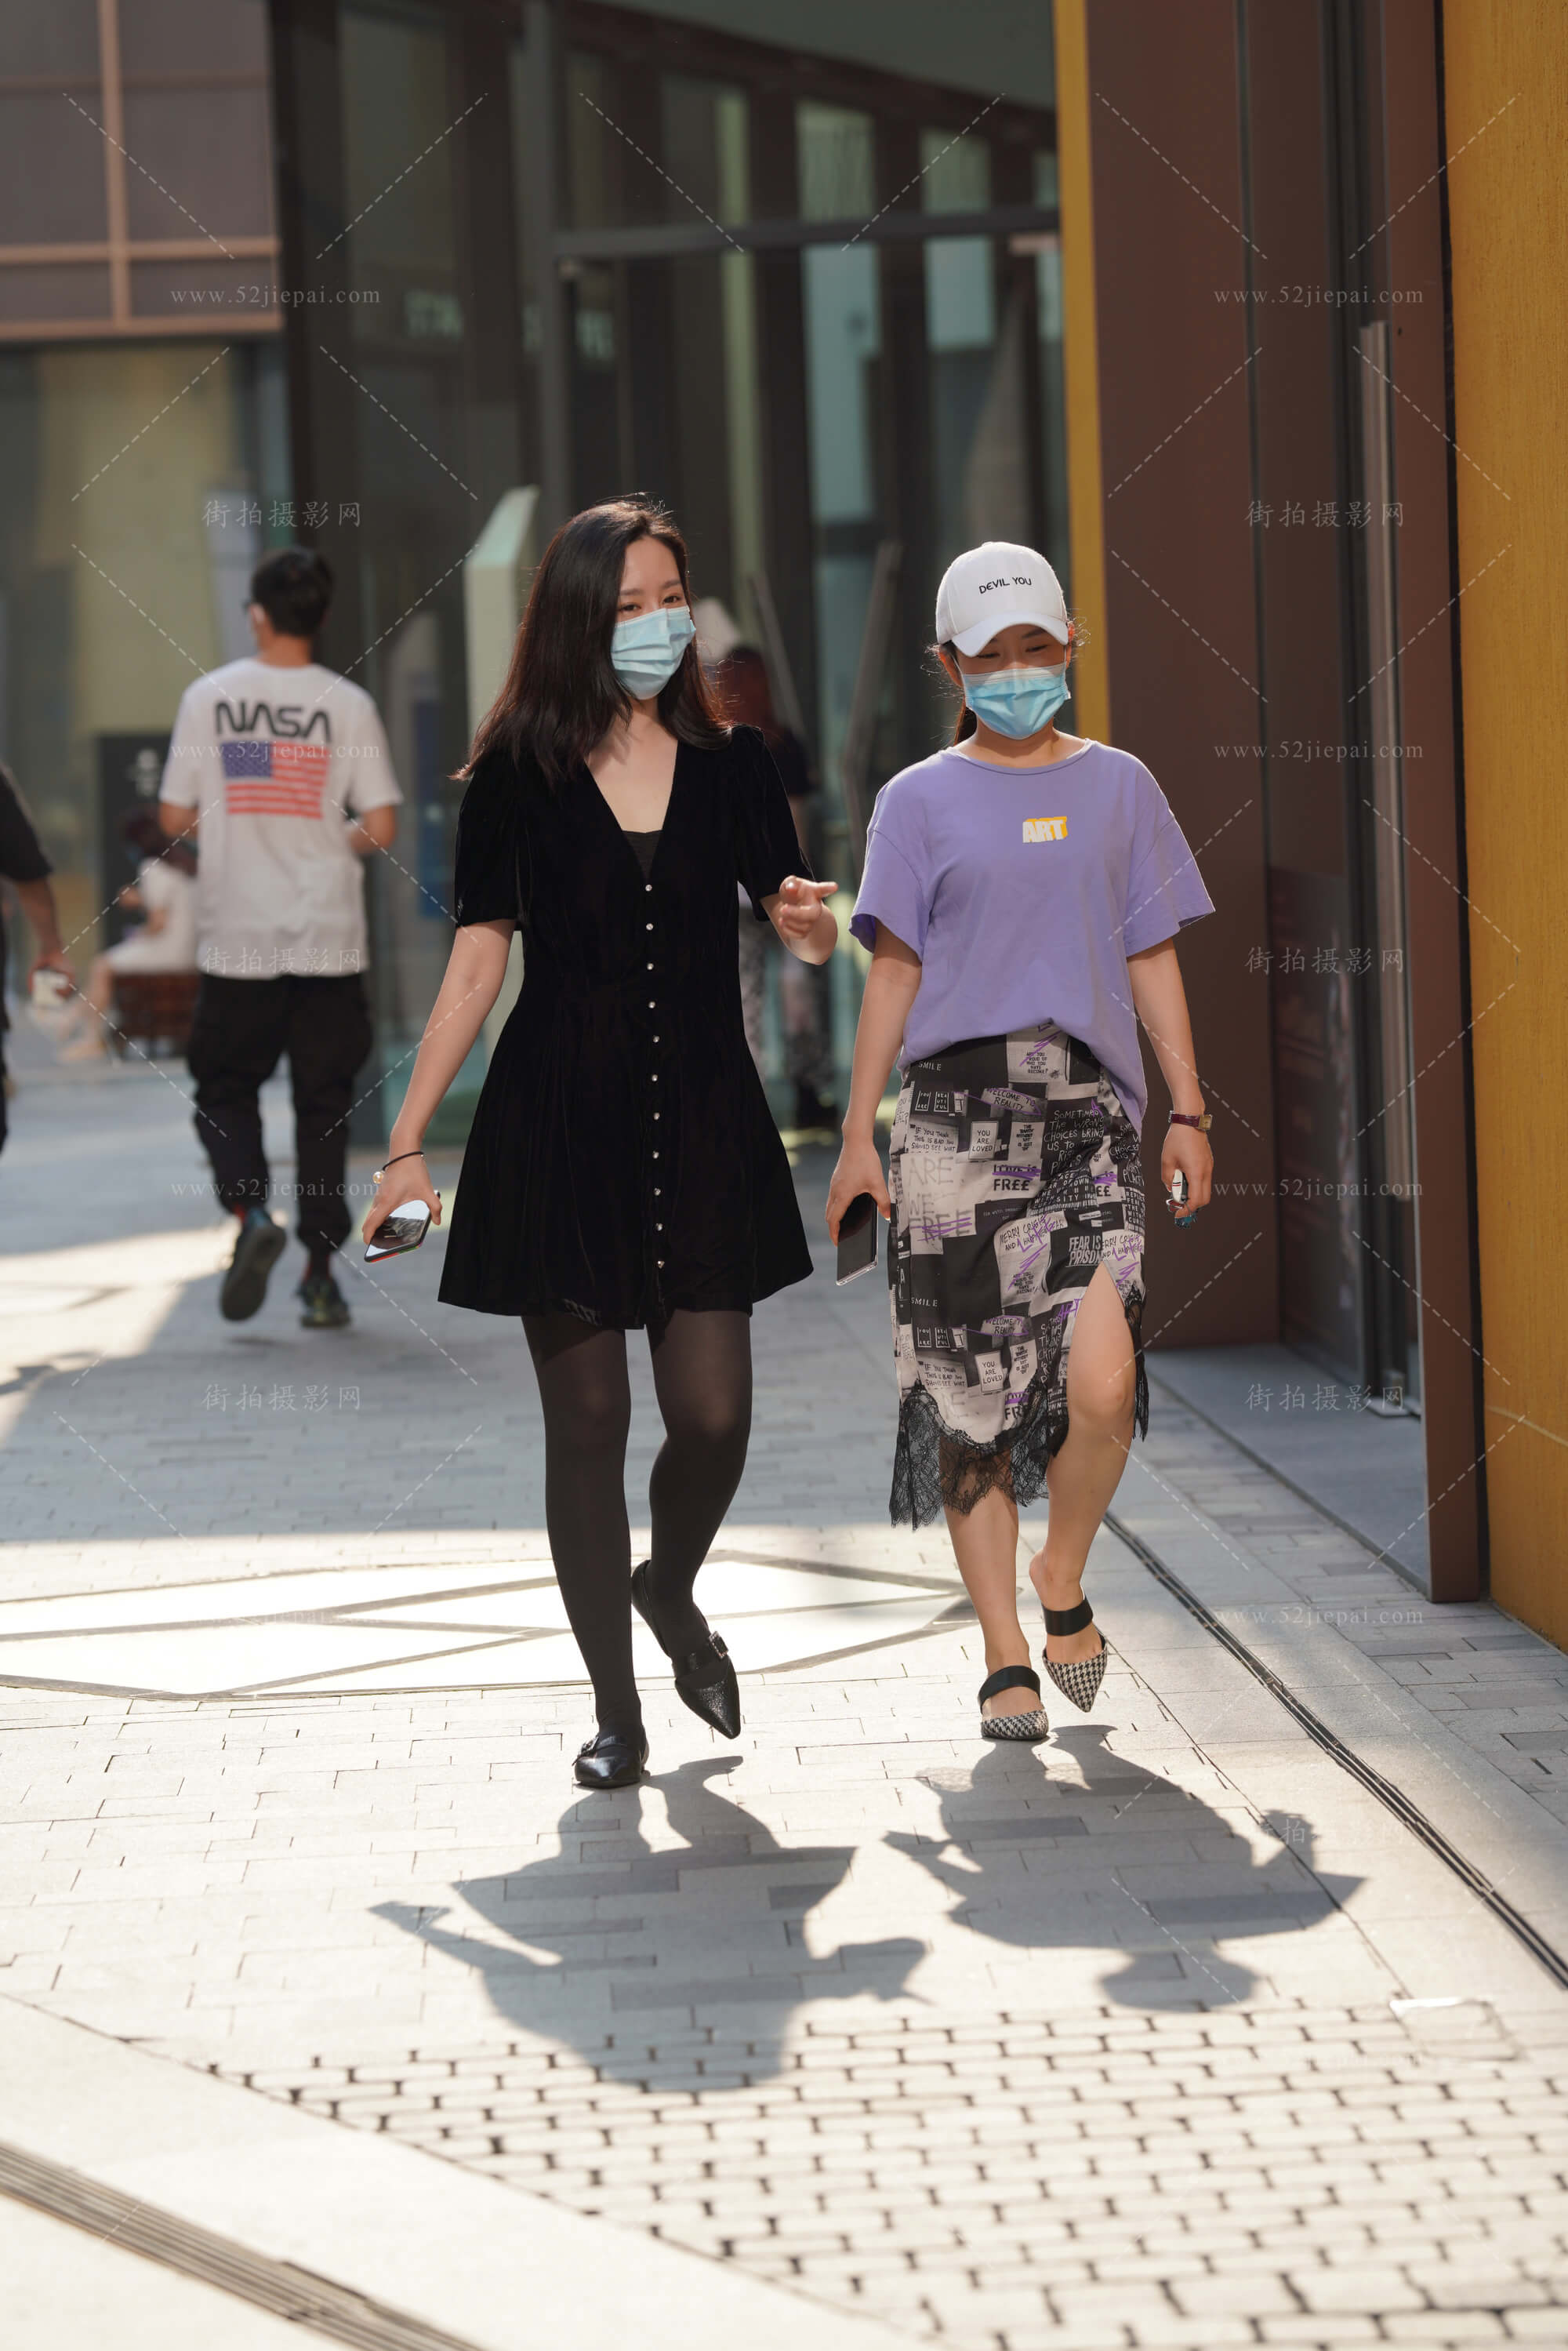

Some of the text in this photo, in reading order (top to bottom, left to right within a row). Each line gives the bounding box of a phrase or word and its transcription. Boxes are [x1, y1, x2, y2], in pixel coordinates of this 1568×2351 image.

[978, 576, 1032, 594] DEVIL YOU
[215, 700, 332, 743] NASA
[1022, 816, 1068, 843] ART
[917, 1061, 942, 1071] SMILE
[987, 1087, 1021, 1101] WELCOME
[994, 1097, 1024, 1110] REALITY
[1069, 1235, 1102, 1252] FEAR IS
[911, 1296, 938, 1307] SMILE
[982, 1375, 1003, 1385] LOVED
